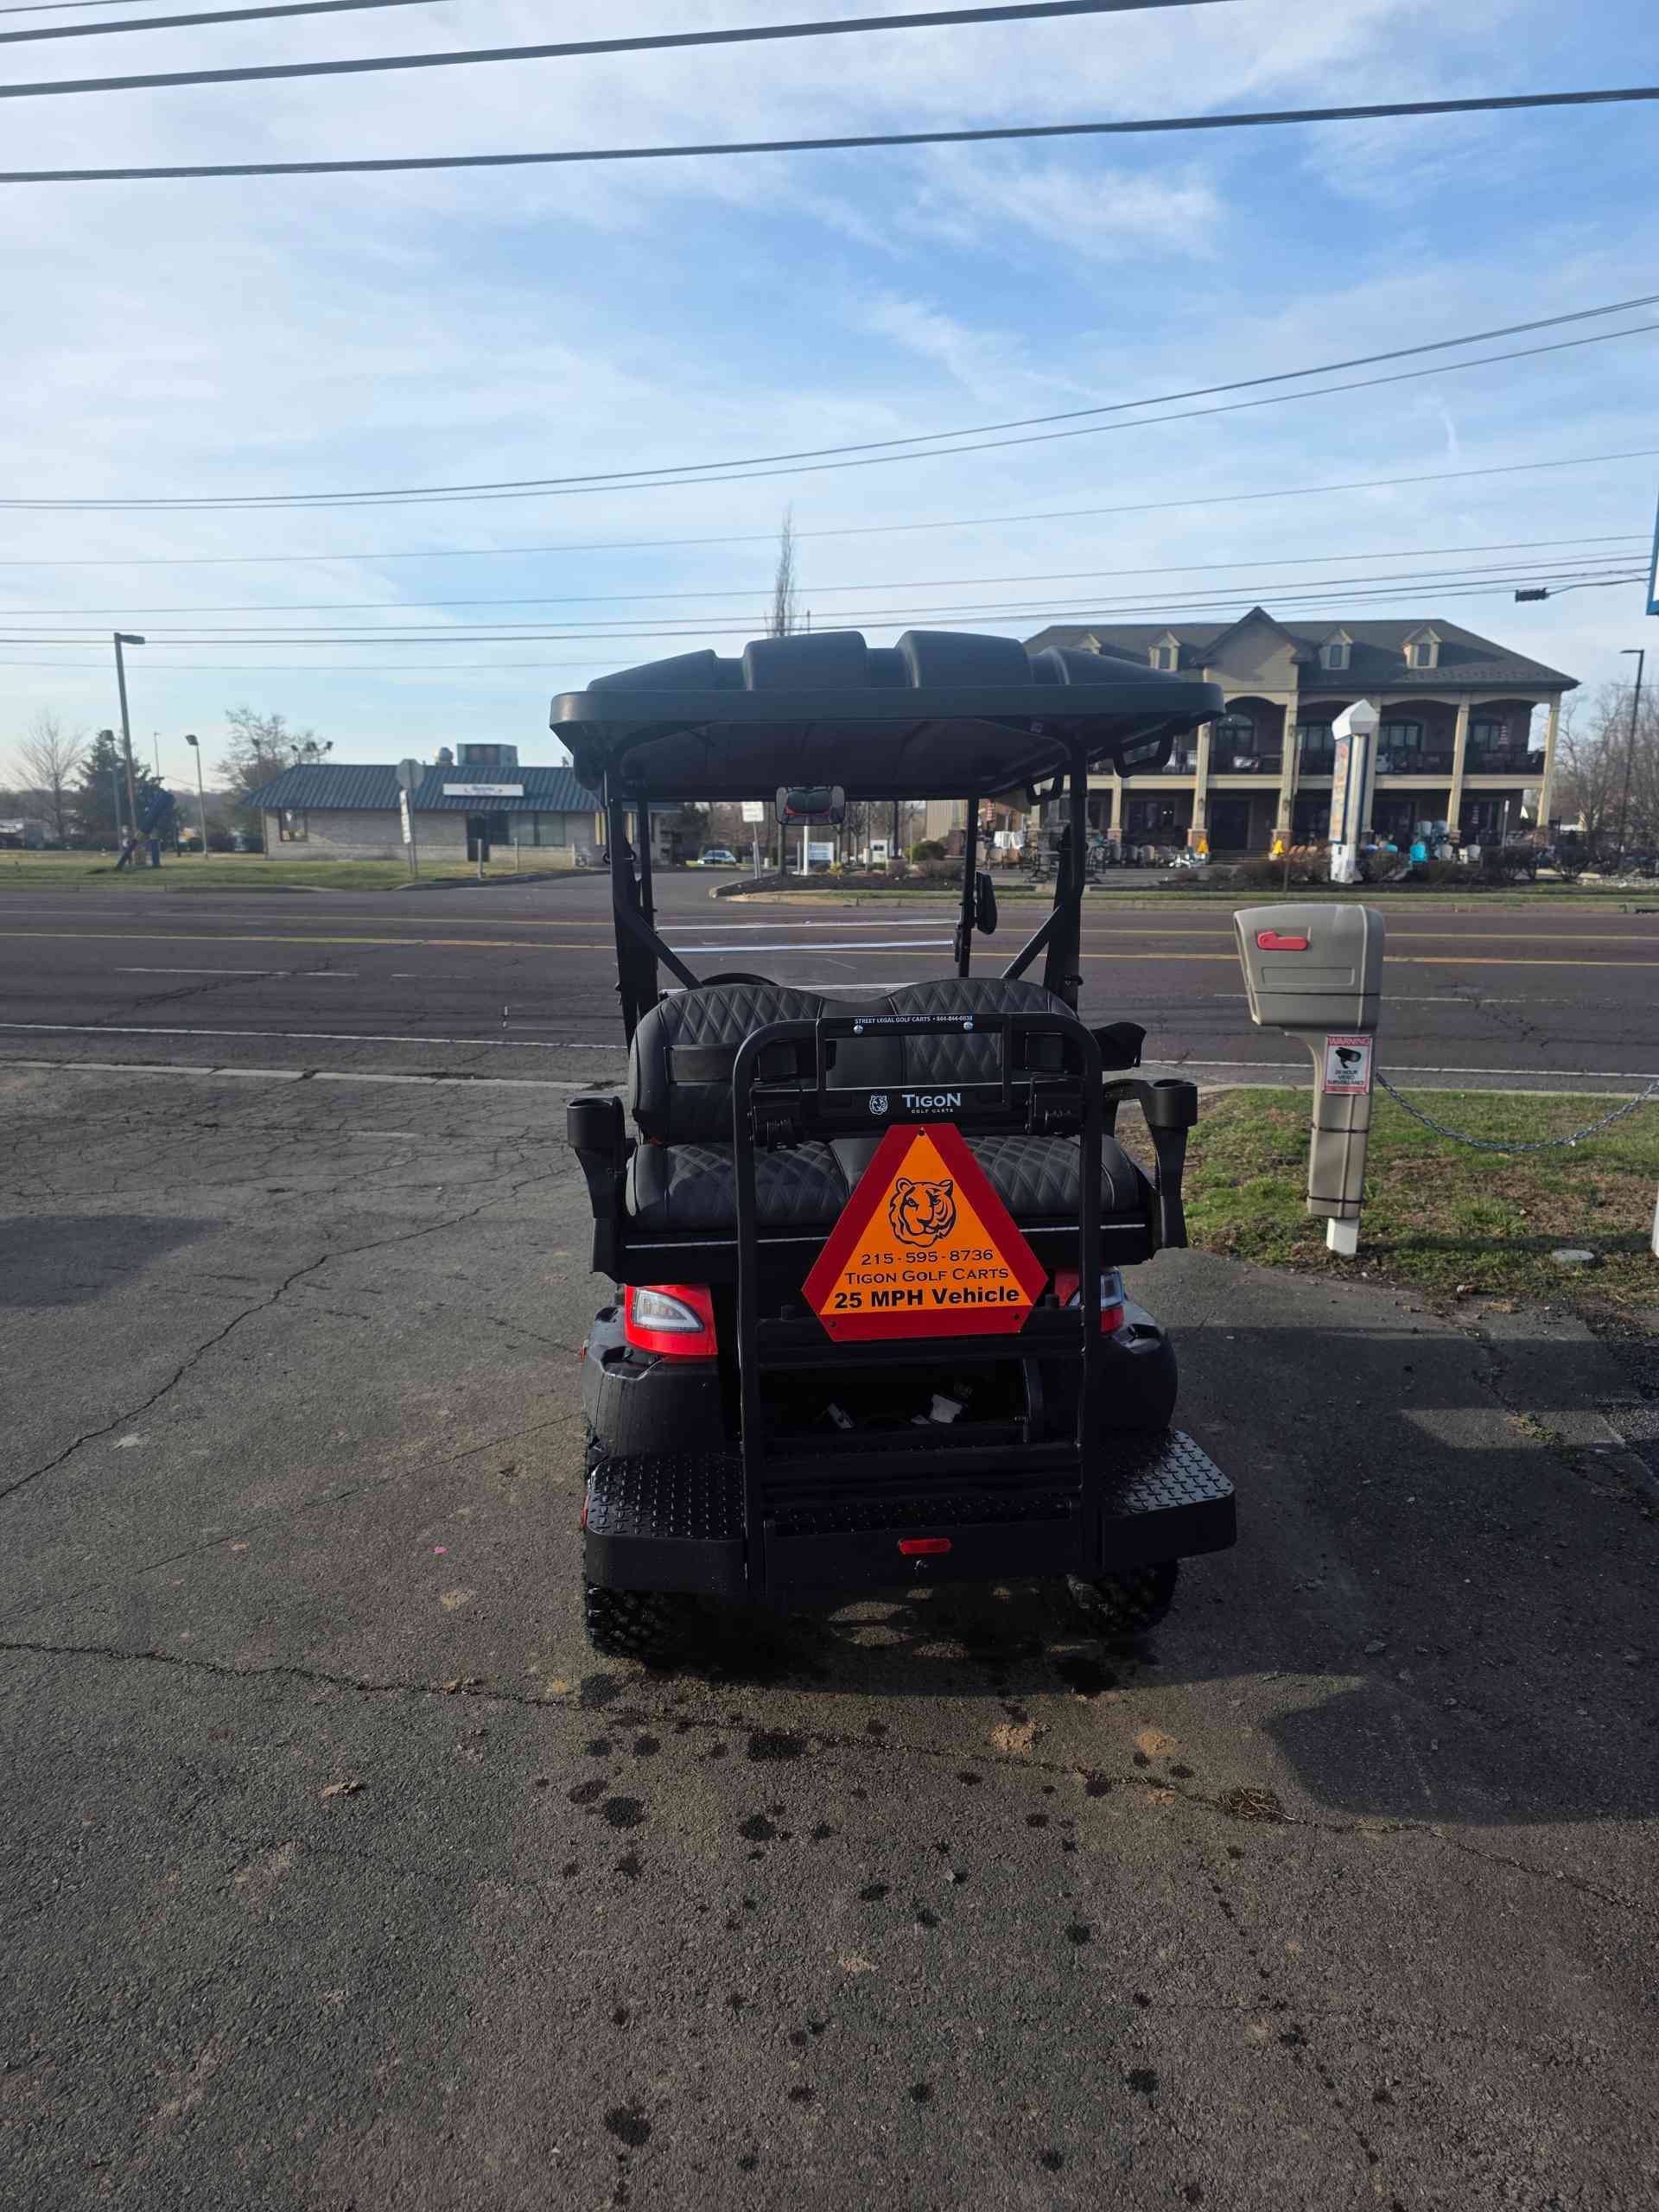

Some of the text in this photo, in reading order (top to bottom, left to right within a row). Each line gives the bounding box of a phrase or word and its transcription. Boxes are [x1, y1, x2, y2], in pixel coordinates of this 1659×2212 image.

[1328, 1037, 1370, 1046] WARNING
[834, 1286, 1020, 1309] 25 MPH Vehicle
